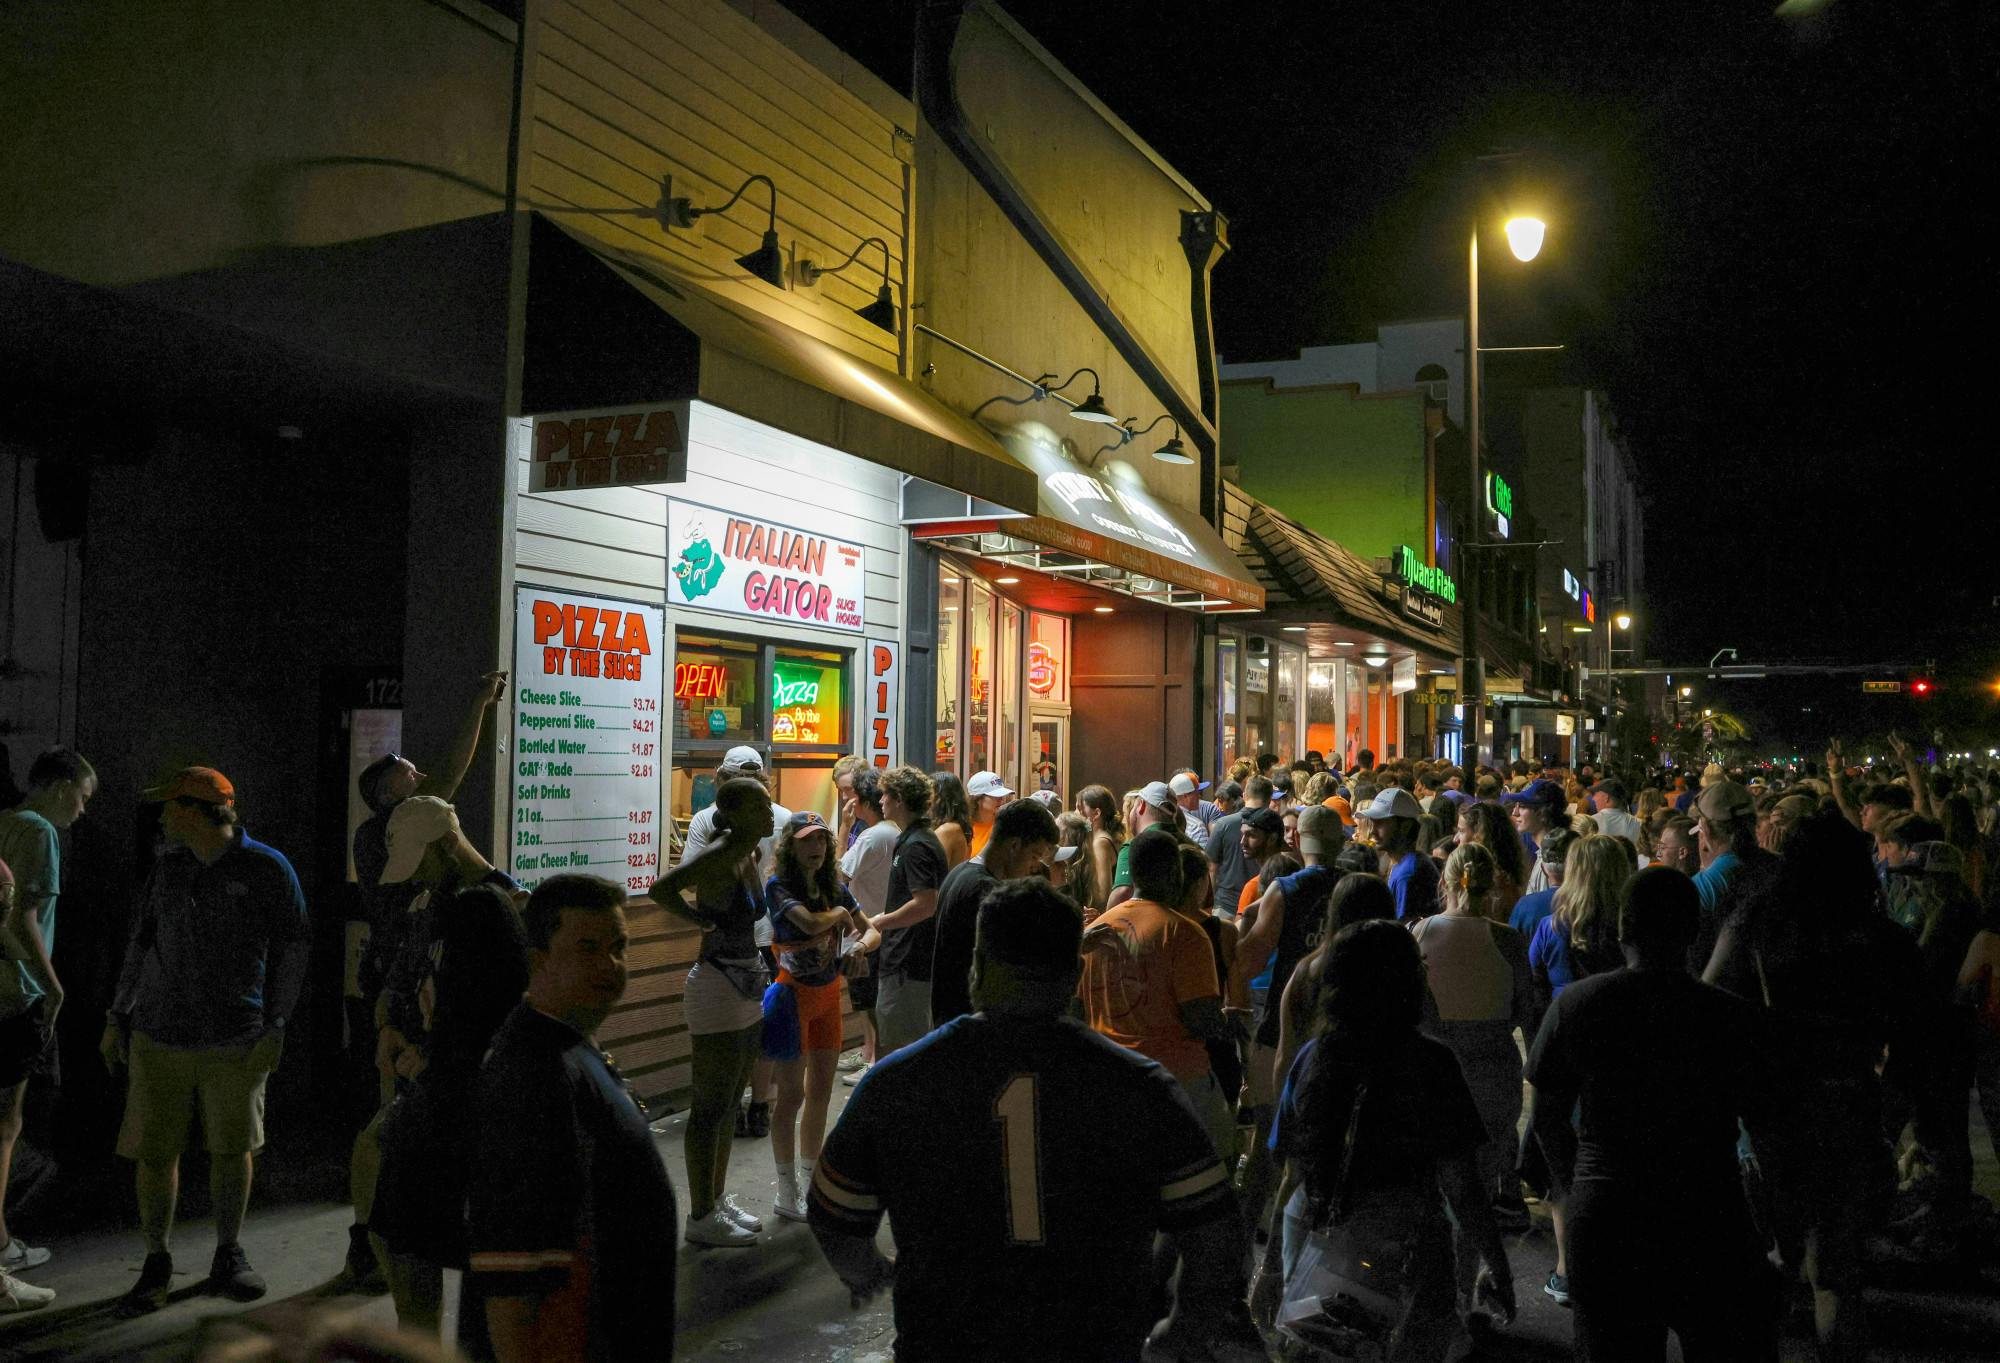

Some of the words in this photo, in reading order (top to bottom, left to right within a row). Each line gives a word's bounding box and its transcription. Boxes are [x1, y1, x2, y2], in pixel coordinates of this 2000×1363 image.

[535, 411, 684, 462] PIZZA
[545, 461, 571, 488] BY
[575, 458, 612, 486] THE
[616, 454, 670, 482] SLICE
[723, 518, 827, 576] ITALIAN
[1402, 544, 1435, 592] Tijuana
[1436, 568, 1456, 604] Flats
[744, 570, 832, 622] GATOR
[836, 597, 856, 612] SLICE
[532, 600, 651, 655] PIZZA
[836, 611, 861, 627] HOUSE
[543, 646, 567, 675] BY
[570, 648, 600, 678] THE
[604, 652, 641, 681] SLICE
[675, 664, 725, 697] OPEN
[520, 688, 556, 705] Cheese
[560, 691, 581, 706] Slice
[633, 698, 655, 711] $3.74
[520, 711, 571, 730] Pepperoni
[574, 714, 595, 729] Slice
[633, 719, 654, 732] $4.21
[520, 738, 555, 754] Bottled
[559, 739, 586, 754] Water
[632, 743, 654, 756] $1.87
[632, 765, 653, 777] $2.81
[518, 784, 538, 800] Soft
[541, 784, 571, 800] Drinks
[517, 808, 543, 823] 21oz.
[629, 811, 652, 823] $1.87
[516, 831, 542, 846] 32oz.
[628, 832, 651, 845] $2.81
[516, 854, 538, 870] Giant
[541, 853, 568, 868] Cheese
[570, 851, 589, 866] Pizza
[628, 853, 657, 867] $22.43
[991, 1071, 1045, 1246] 1
